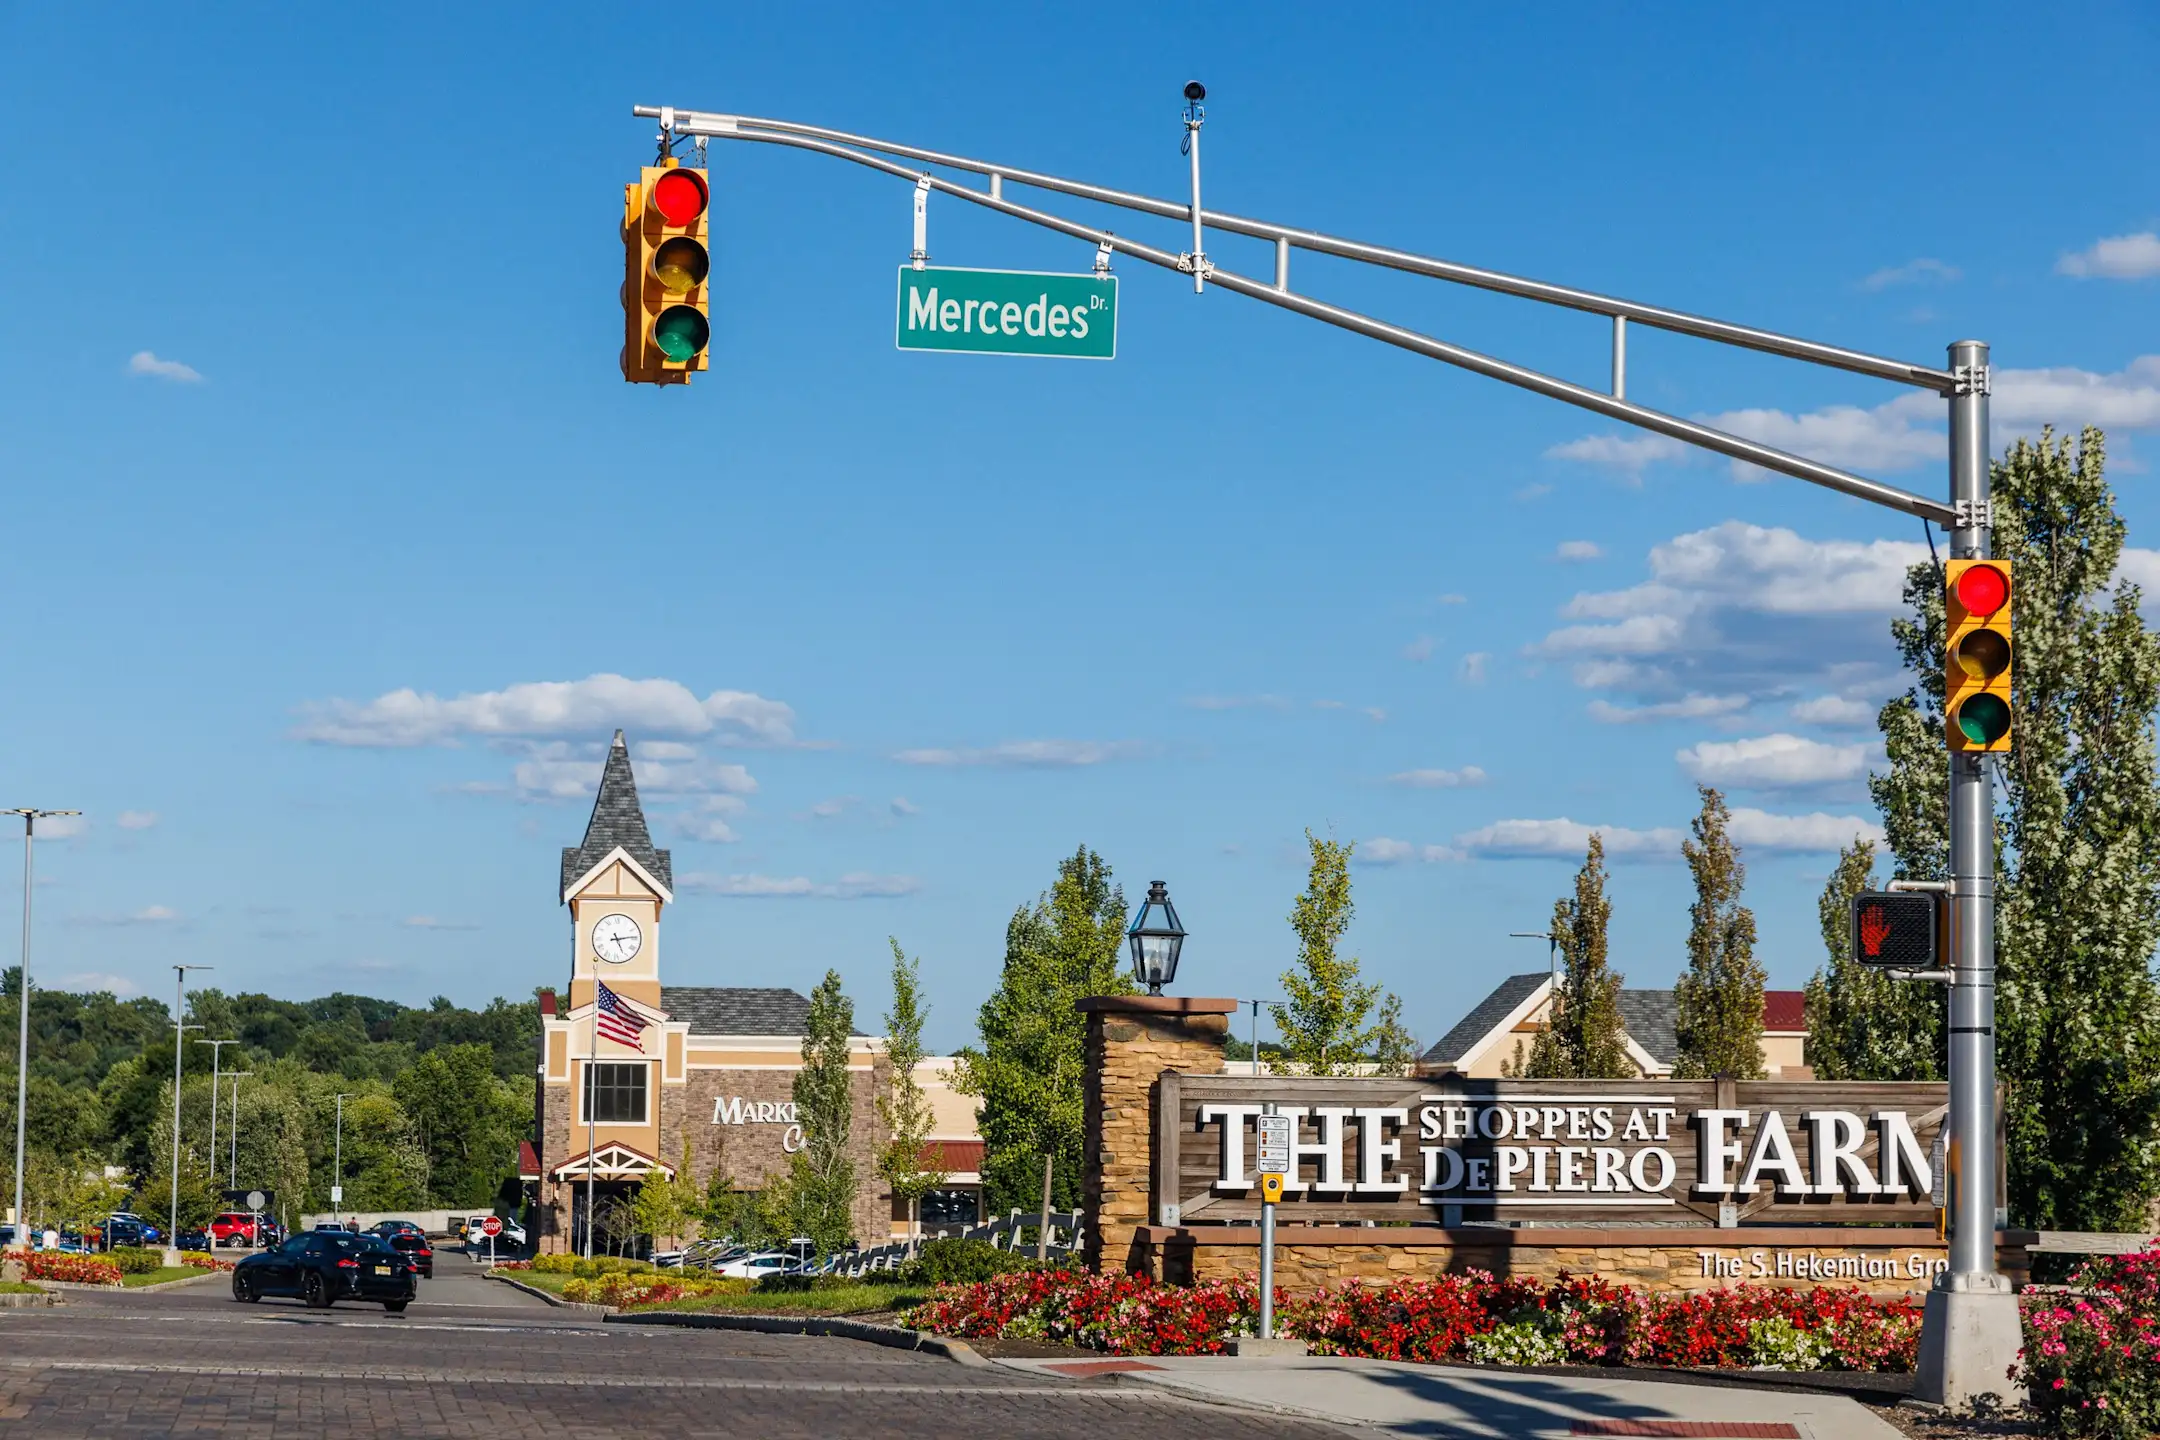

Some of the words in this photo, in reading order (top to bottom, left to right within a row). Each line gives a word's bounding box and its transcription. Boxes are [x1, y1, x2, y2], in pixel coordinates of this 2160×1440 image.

[908, 286, 1089, 339] Mercedes
[1090, 295, 1109, 310] Dr.
[711, 1096, 802, 1125] MARKE
[1419, 1106, 1613, 1140] SHOPPES
[1622, 1107, 1676, 1141] AT
[1202, 1104, 1409, 1192] THE
[483, 1222, 501, 1231] STOP
[1699, 1251, 1744, 1276] The
[1908, 1253, 1949, 1278] Gro
